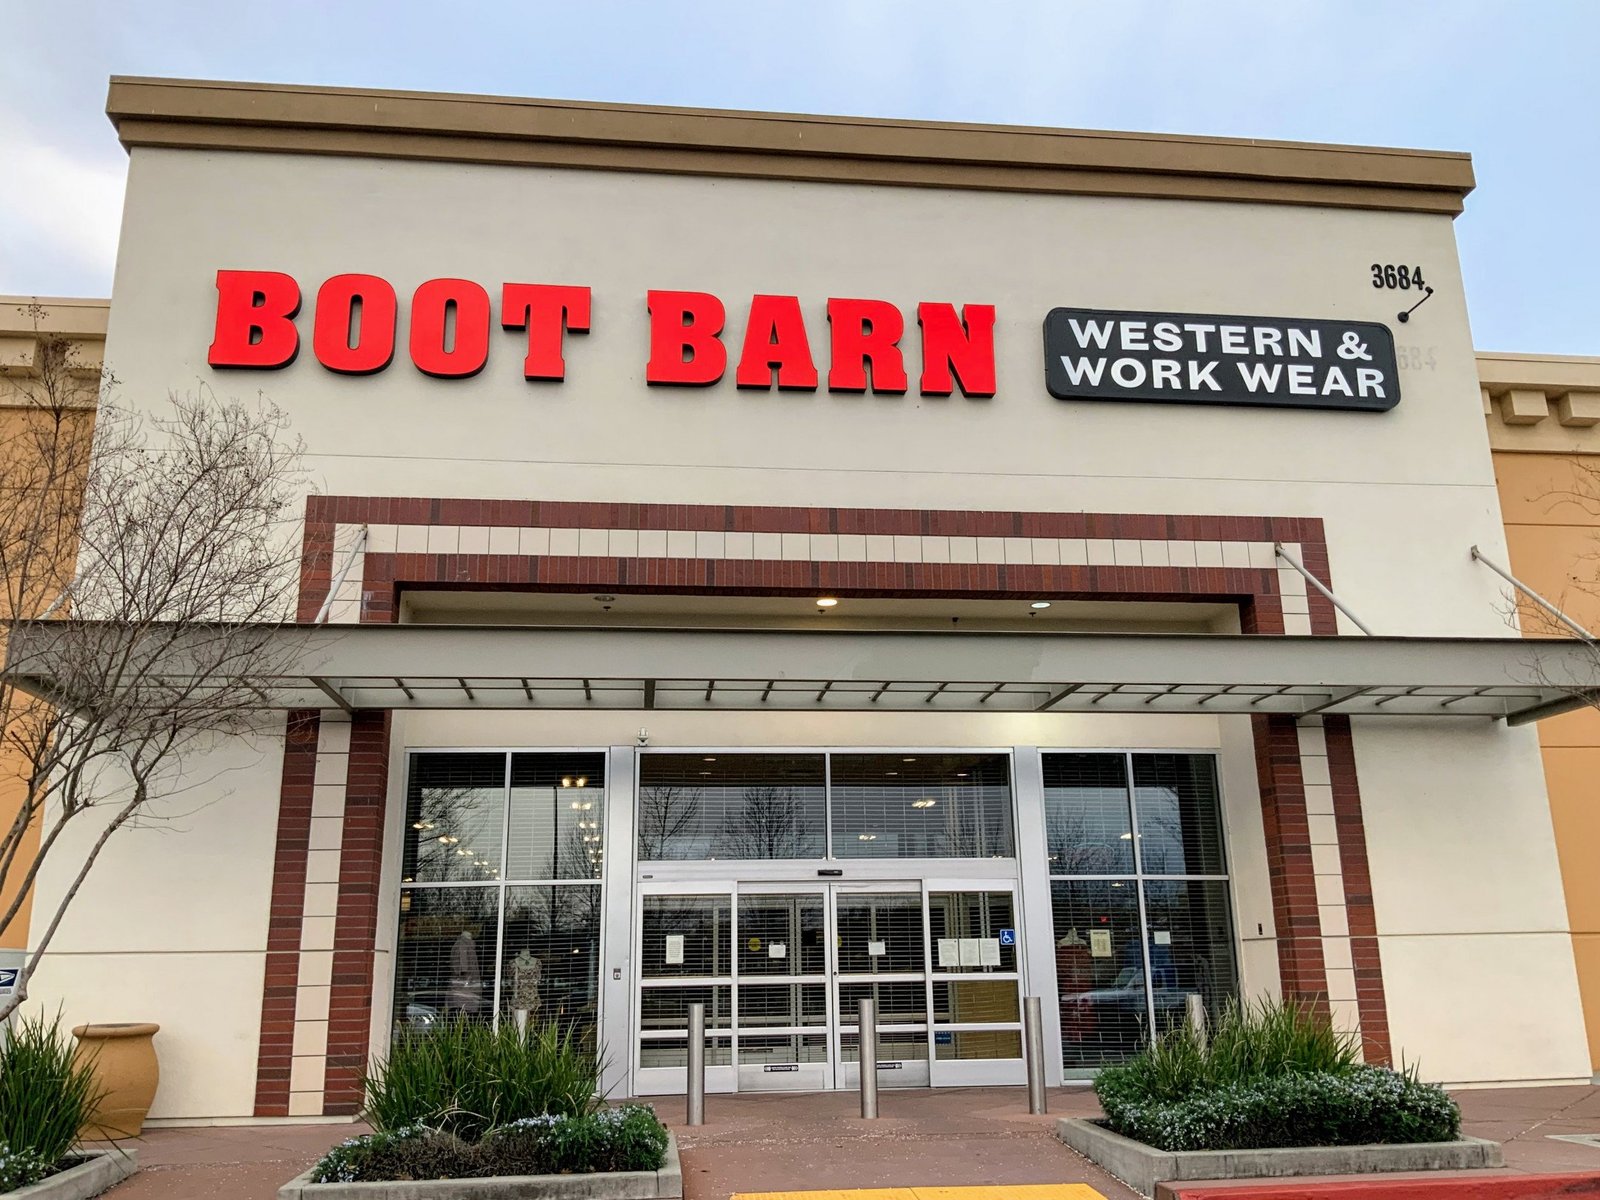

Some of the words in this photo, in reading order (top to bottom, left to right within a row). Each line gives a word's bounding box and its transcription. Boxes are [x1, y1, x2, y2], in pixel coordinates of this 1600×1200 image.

[1371, 264, 1425, 290] 3684
[208, 269, 591, 381] BOOT
[646, 289, 996, 399] BARN
[1068, 318, 1323, 359] WESTERN
[1336, 330, 1373, 361] &
[1060, 355, 1223, 392] WORK
[1237, 362, 1387, 399] WEAR
